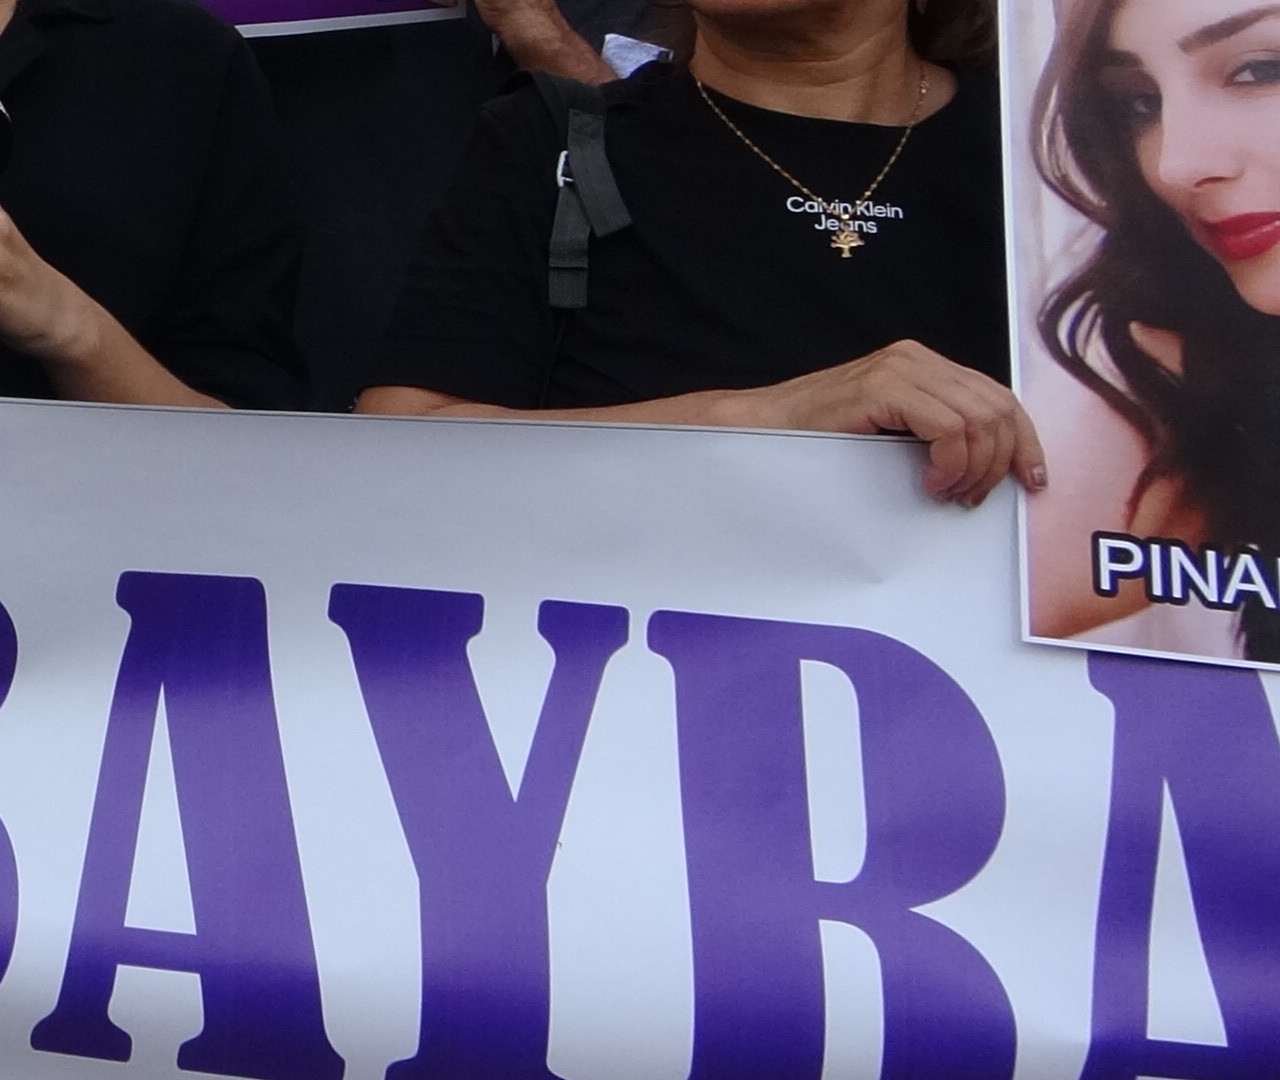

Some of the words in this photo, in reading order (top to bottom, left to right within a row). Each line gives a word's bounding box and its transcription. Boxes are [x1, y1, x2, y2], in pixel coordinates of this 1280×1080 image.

[786, 196, 852, 215] Calvin
[856, 201, 904, 219] Klein
[814, 214, 878, 234] Jeans
[1097, 537, 1280, 609] PINA
